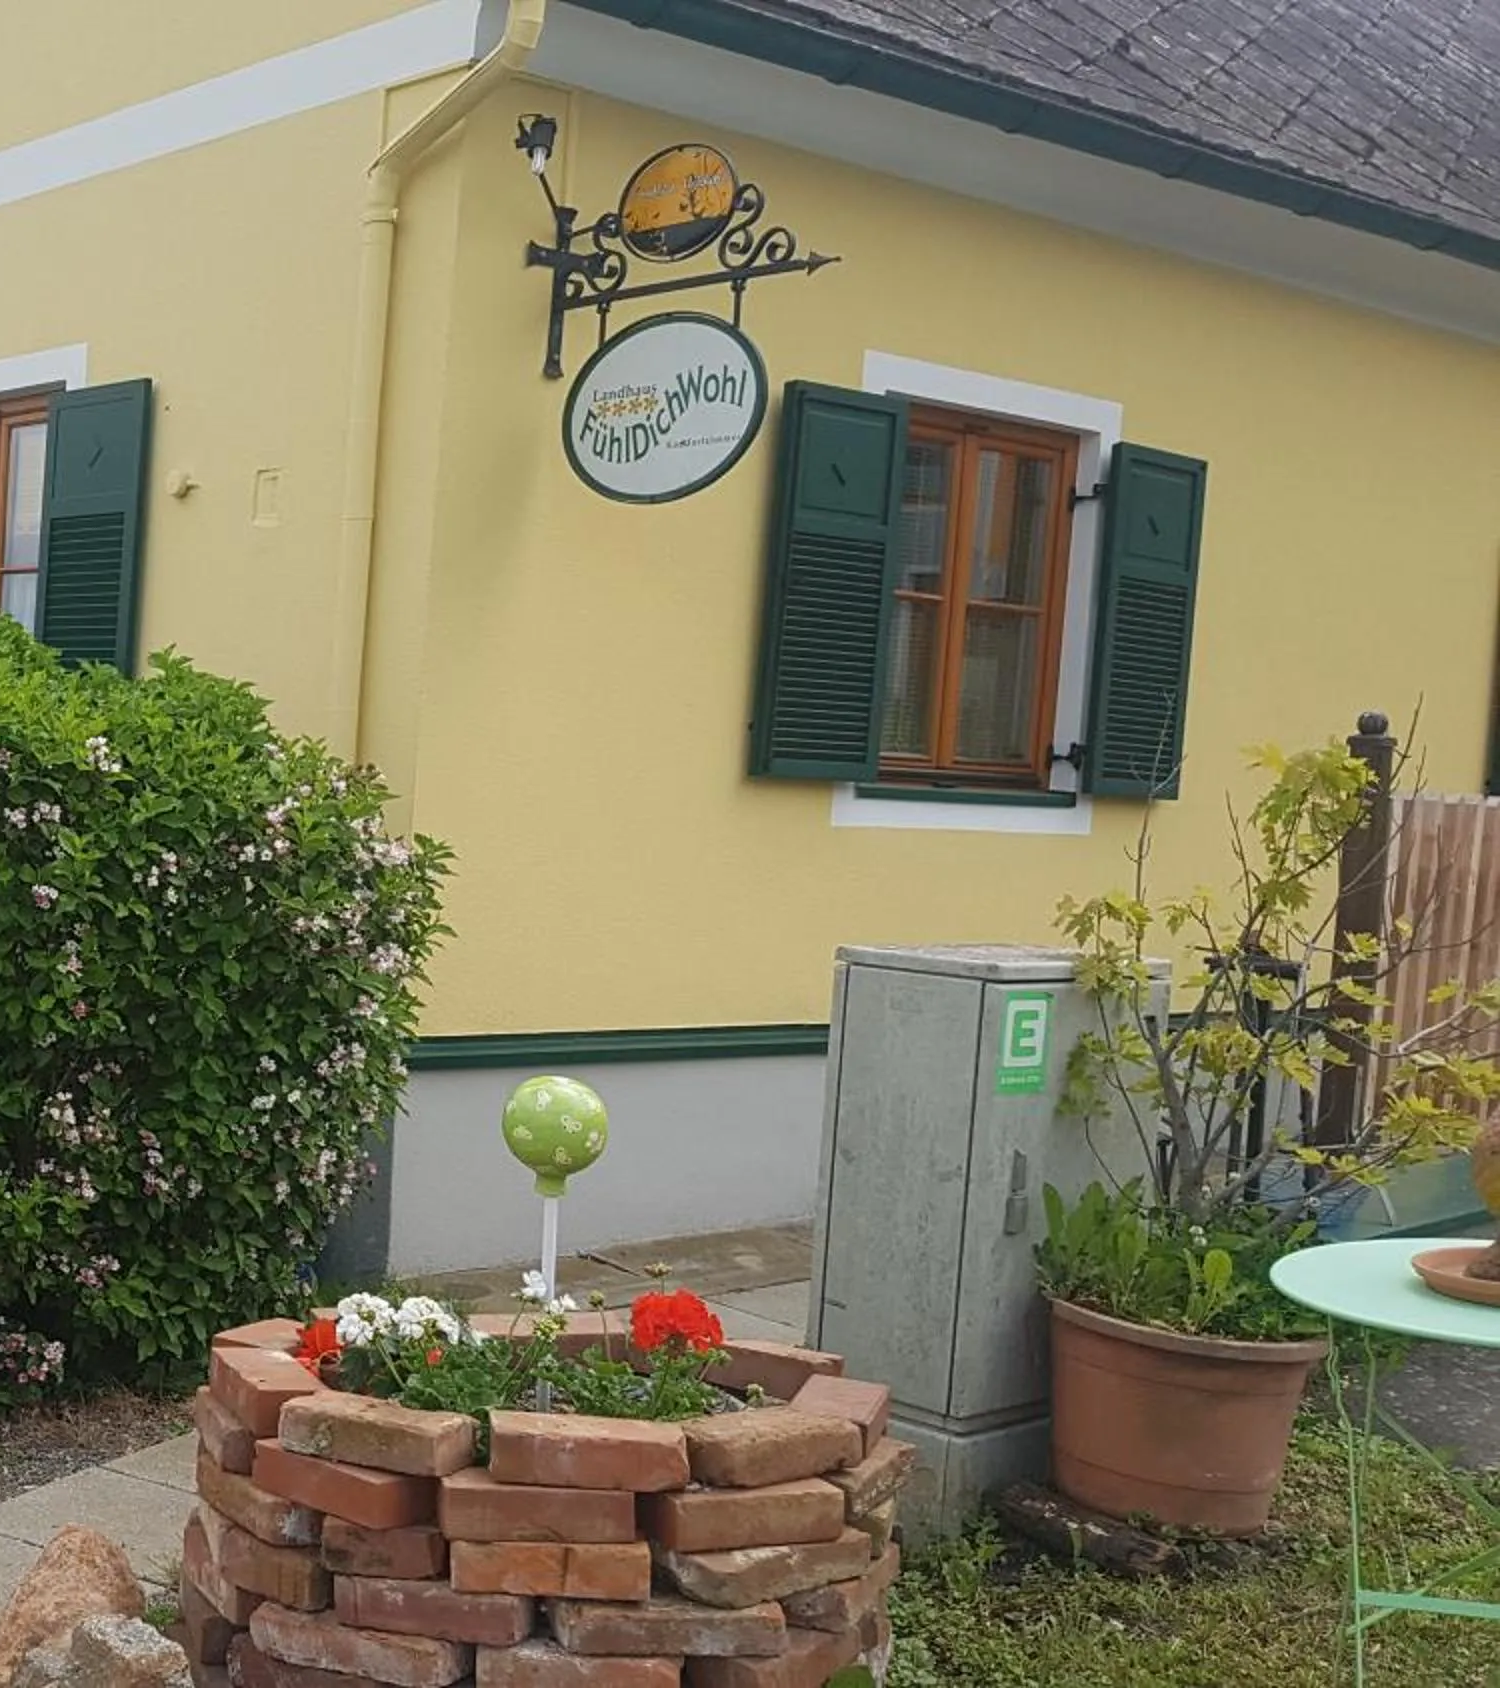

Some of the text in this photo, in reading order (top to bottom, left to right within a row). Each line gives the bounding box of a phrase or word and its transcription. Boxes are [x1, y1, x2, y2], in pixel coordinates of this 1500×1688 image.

[579, 363, 748, 464] FühlDichWohl
[593, 383, 658, 403] Landhaus
[1011, 1010, 1040, 1058] E
